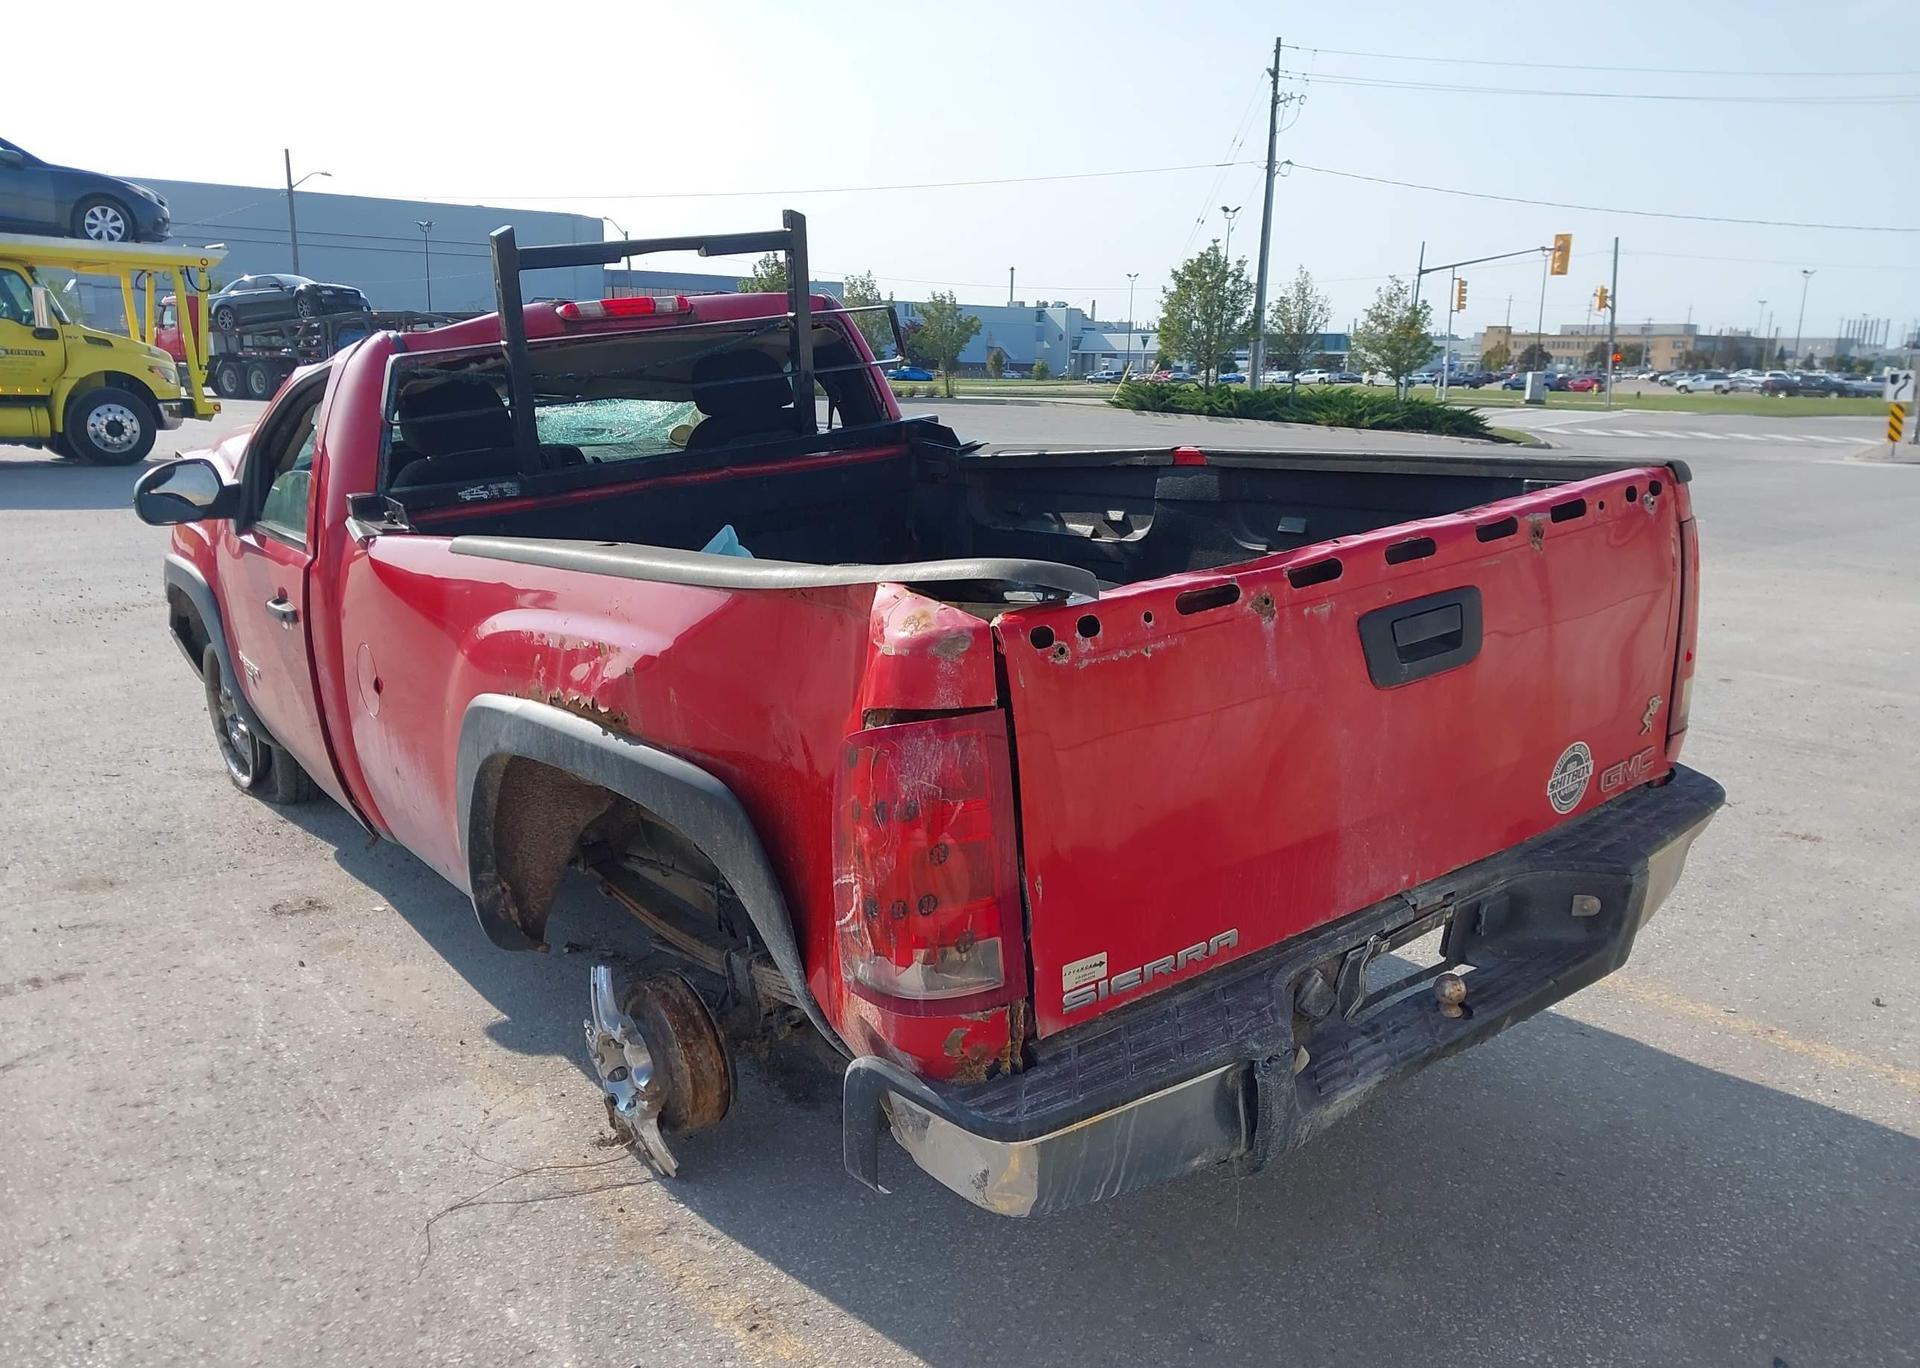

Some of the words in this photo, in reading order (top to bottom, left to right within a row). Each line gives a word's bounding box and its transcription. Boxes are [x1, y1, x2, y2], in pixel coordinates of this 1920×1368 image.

[1549, 762, 1592, 792] SHITBOX
[1601, 746, 1655, 793] GMC
[1062, 928, 1238, 1015] SIERRA
